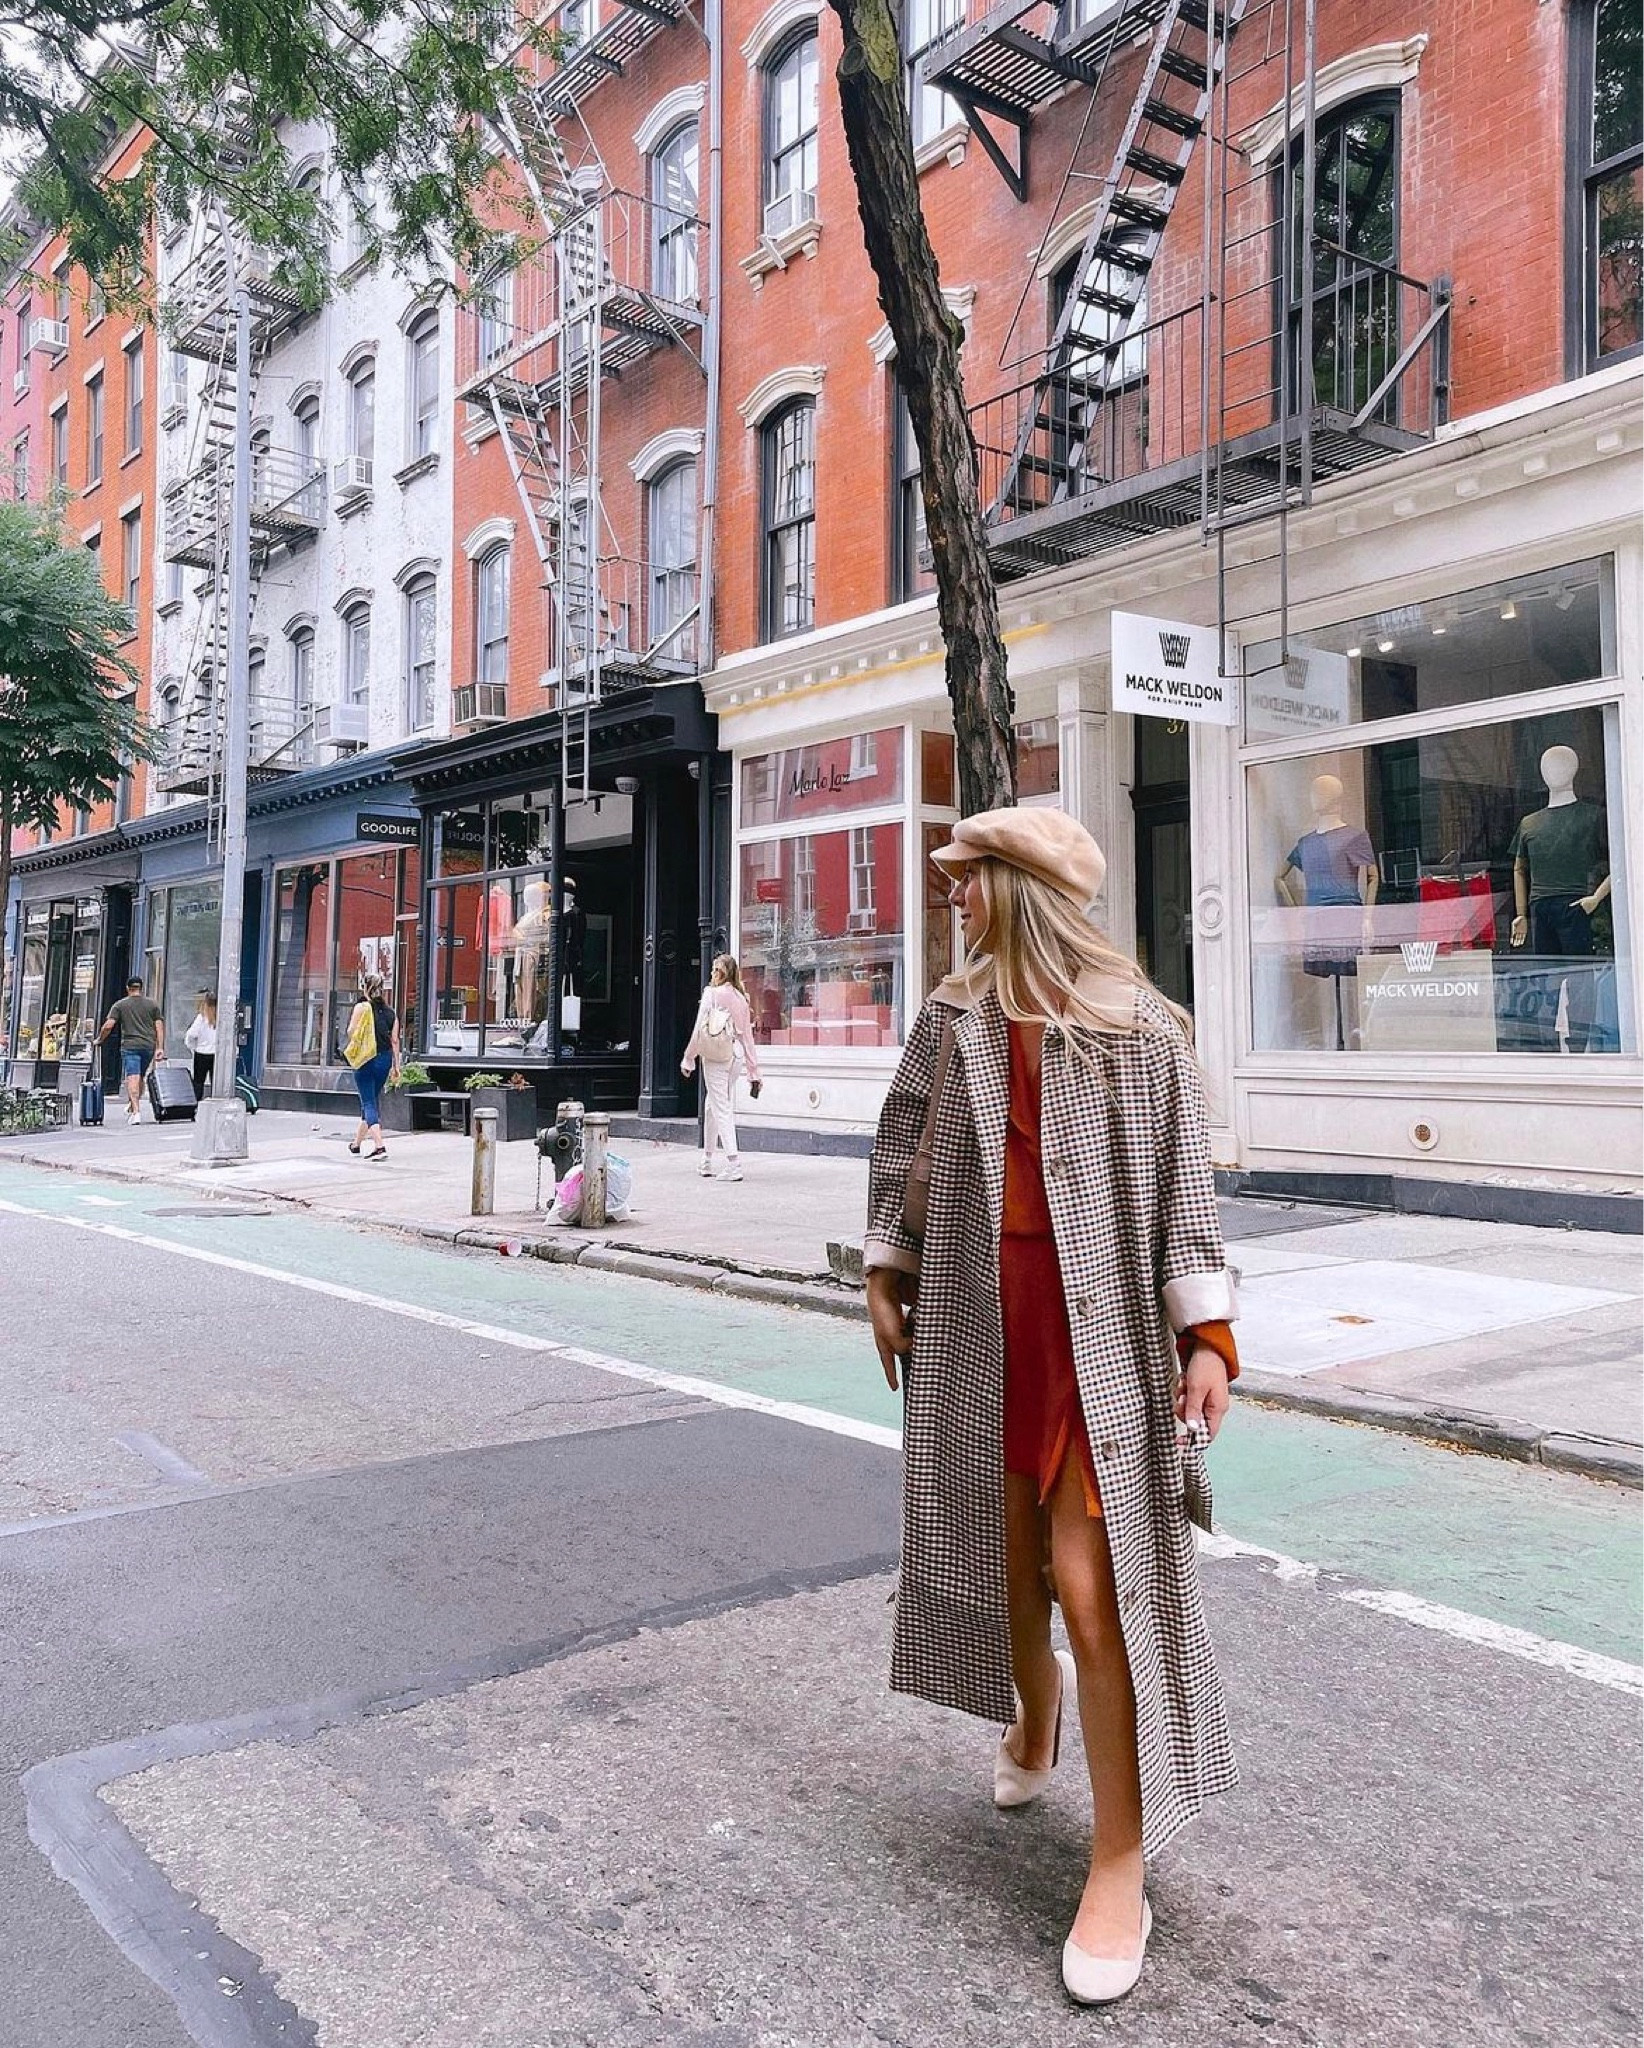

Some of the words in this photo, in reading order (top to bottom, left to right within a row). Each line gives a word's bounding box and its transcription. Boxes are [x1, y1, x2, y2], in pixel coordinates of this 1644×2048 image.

[1126, 673, 1163, 694] MACK
[1167, 679, 1222, 701] WELDON
[788, 767, 828, 798] Marlo
[828, 763, 851, 792] Laz
[360, 822, 418, 837] GOODLIFE
[1366, 983, 1407, 998] MACK
[1408, 981, 1479, 997] WELDON
